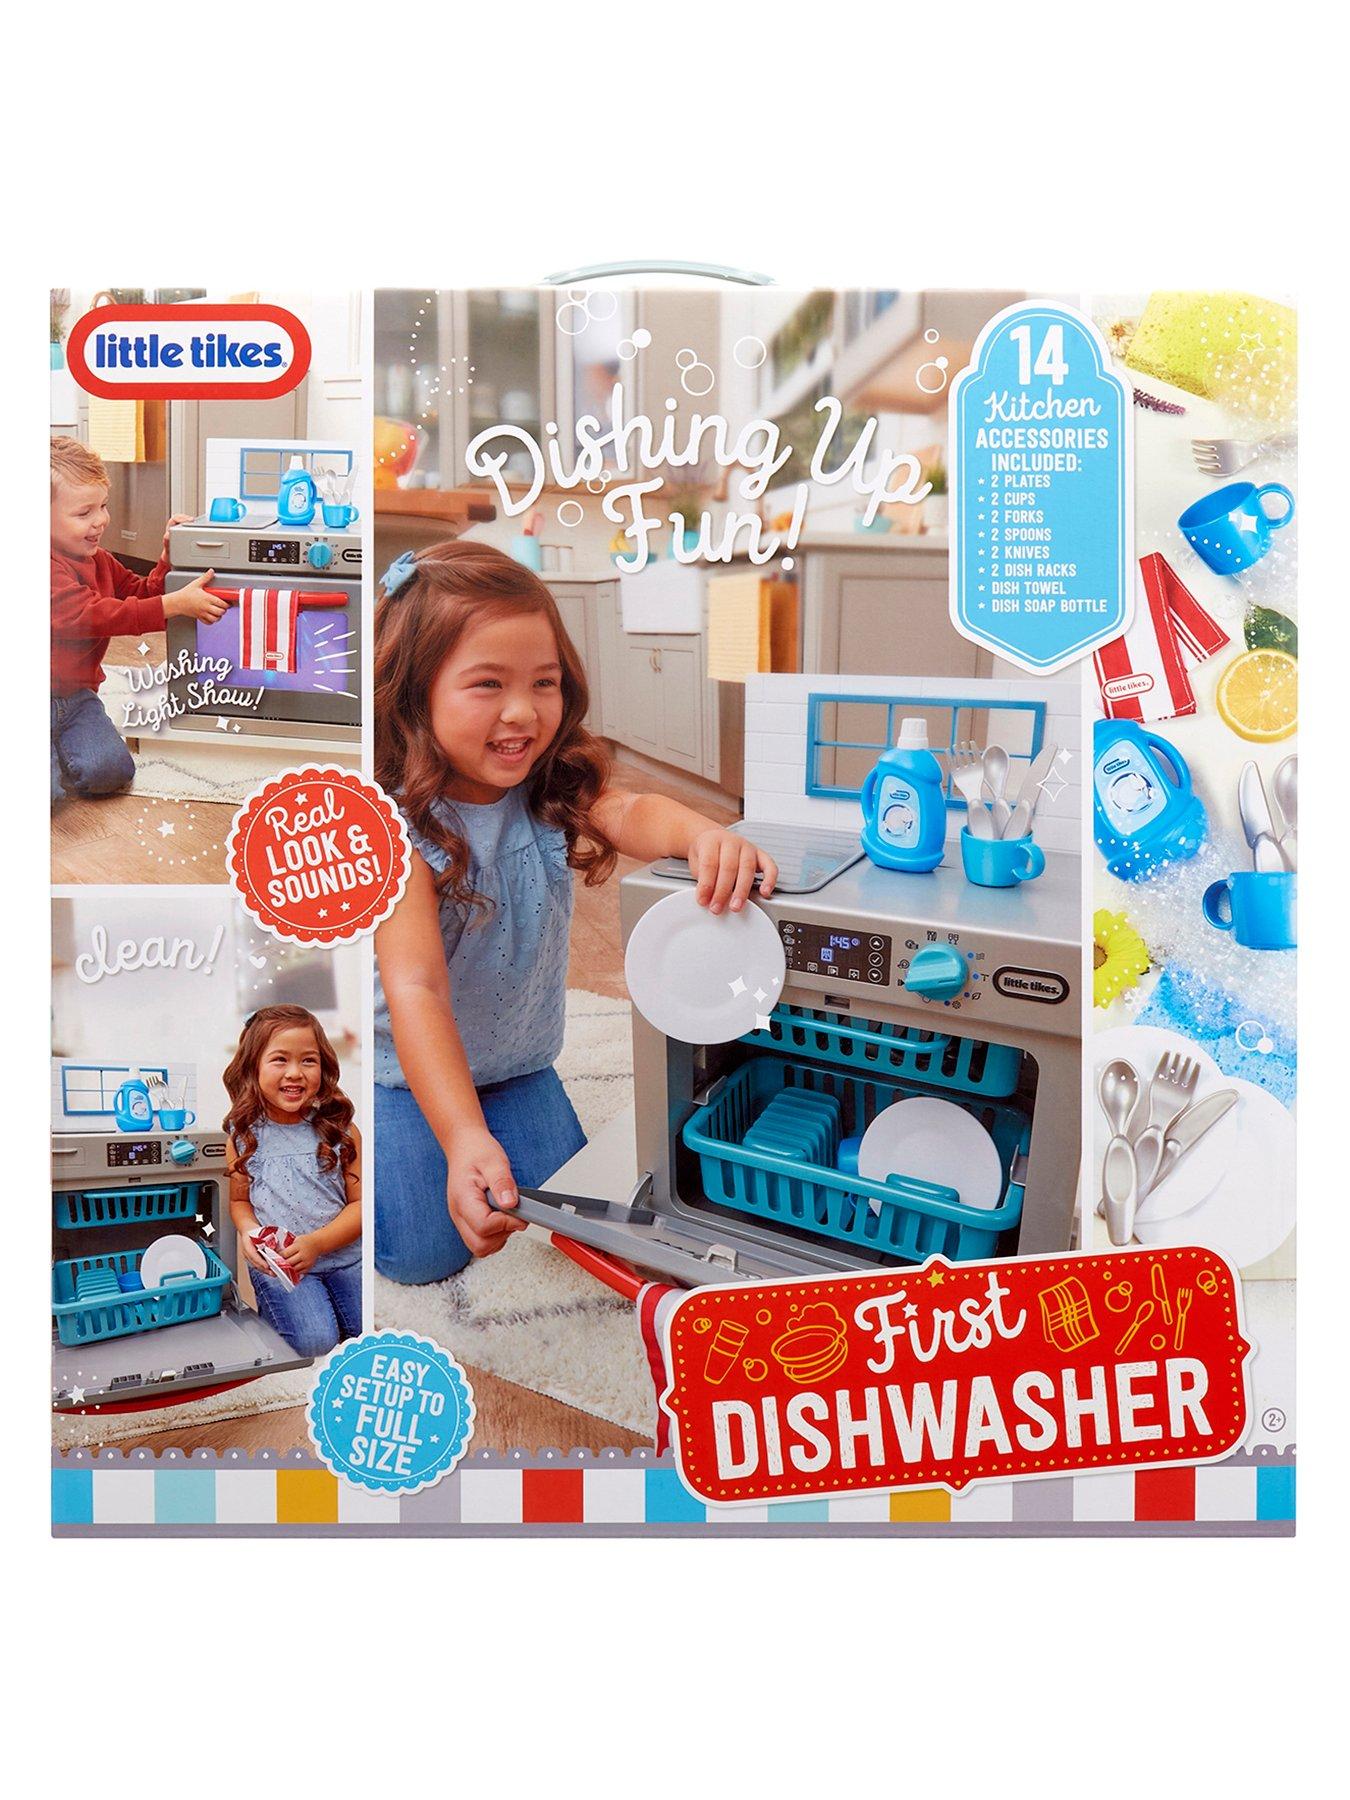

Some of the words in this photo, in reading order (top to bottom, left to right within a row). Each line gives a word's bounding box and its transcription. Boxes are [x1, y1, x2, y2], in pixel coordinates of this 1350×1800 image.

[96, 333, 184, 368] little
[1010, 325, 1069, 386] 14
[984, 388, 1101, 423] Kitchen
[465, 382, 793, 516] Dishing
[810, 397, 933, 527] Up
[976, 428, 1108, 449] ACCESSORIES
[992, 453, 1083, 472] INCLUDED:
[991, 475, 999, 488] 2
[1004, 475, 1051, 488] PLATES
[991, 492, 999, 505] 2
[1004, 492, 1036, 505] CUPS
[602, 477, 808, 573] Fun!
[991, 510, 999, 523] 2
[1004, 510, 1044, 523] FORKS
[991, 528, 999, 541] 2
[1004, 528, 1052, 541] SPOONS
[991, 546, 999, 559] 2
[1004, 546, 1050, 559] KNIVES
[991, 563, 999, 577] 2
[1004, 563, 1032, 577] DISH
[1037, 563, 1077, 577] RACKS
[992, 581, 1020, 594] DISH
[1024, 581, 1066, 594] TOWEL
[992, 599, 1020, 612] DISH
[1024, 599, 1056, 612] SOAP
[1061, 599, 1108, 612] BOTTLE
[124, 649, 232, 692] Washing
[122, 693, 185, 731] Light
[187, 679, 264, 710] Show!
[265, 788, 345, 841] Real
[265, 830, 345, 876] LOOK
[347, 824, 373, 854] &
[267, 854, 383, 908] SOUNDS!
[76, 925, 224, 983] clean!
[1003, 976, 1028, 989] little
[855, 1273, 1027, 1373] First
[371, 1354, 430, 1387] EASY
[340, 1374, 414, 1409] SETUP
[419, 1390, 445, 1416] TO
[355, 1404, 422, 1446] FULL
[712, 1358, 1213, 1481] DISHWASHER
[1269, 1413, 1281, 1426] 2+
[350, 1436, 416, 1476] SIZE
